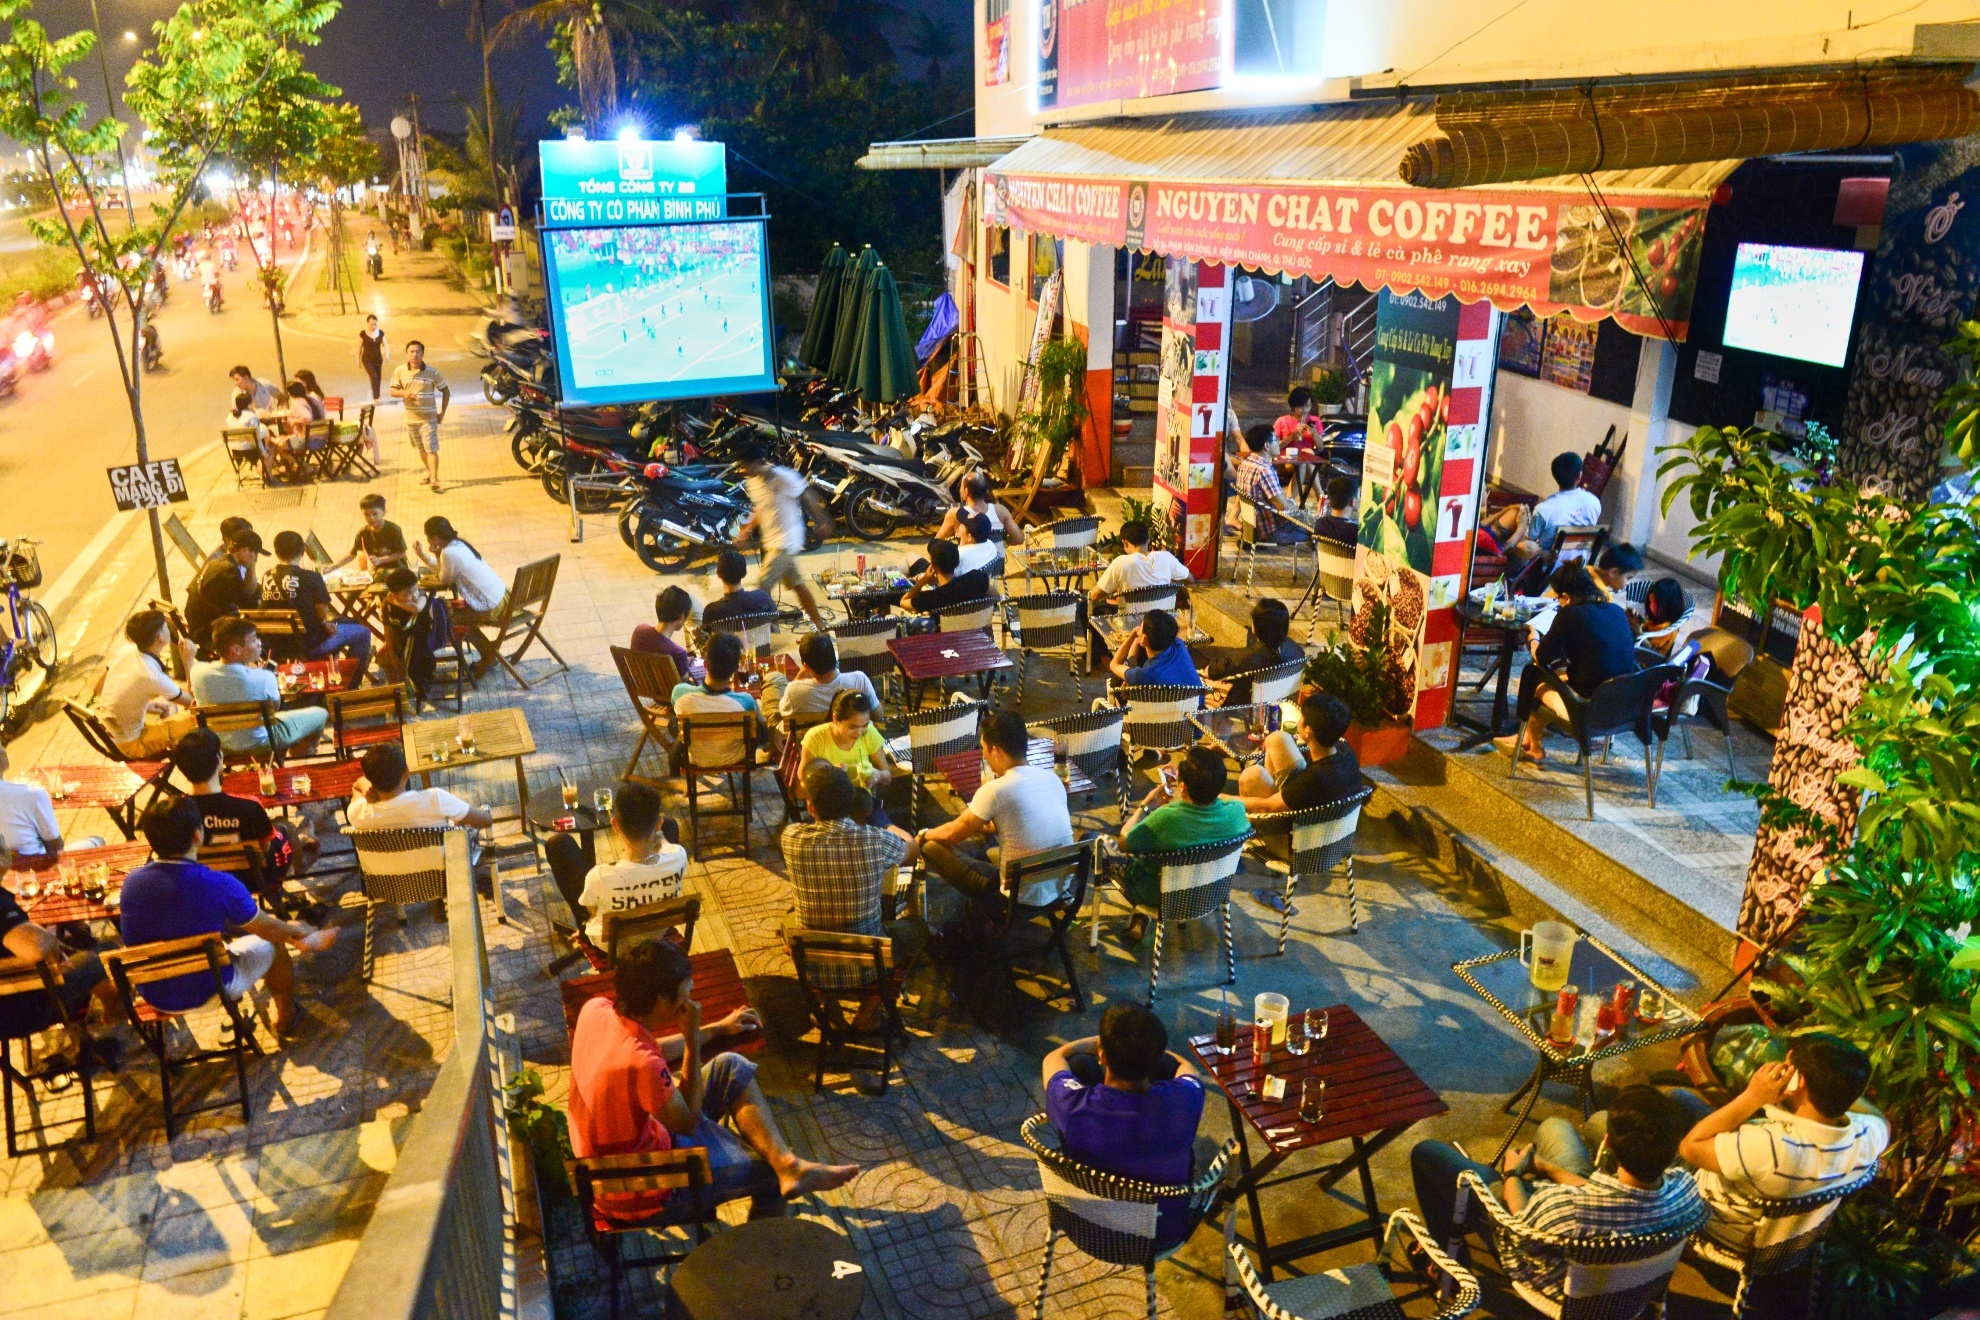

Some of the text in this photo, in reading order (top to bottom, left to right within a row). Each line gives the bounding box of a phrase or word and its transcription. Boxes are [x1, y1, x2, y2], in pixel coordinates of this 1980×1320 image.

[658, 181, 675, 194] TY
[1008, 181, 1045, 209] NGUYEN
[1046, 182, 1075, 214] CHAT
[1075, 185, 1121, 219] COFFEE
[550, 196, 585, 220] CÔNG
[588, 201, 603, 220] TY
[664, 197, 692, 219] BÌNH
[695, 196, 720, 218] PHÚ
[1156, 189, 1261, 225] NGUYEN
[1266, 193, 1359, 234] CHAT
[1367, 199, 1549, 251] COFFEE
[1273, 232, 1531, 277] Cung cấp sỉ & lẻ cà phê rang xay
[1391, 271, 1450, 289] 0902.542.149
[1460, 279, 1538, 300] 016.2694.2964
[1869, 344, 1945, 387] Nam
[111, 460, 179, 488] CAFE
[114, 476, 185, 503] MANG ĐI
[133, 493, 171, 511] 12K
[261, 591, 298, 602] GROP
[831, 1260, 862, 1279] 4
